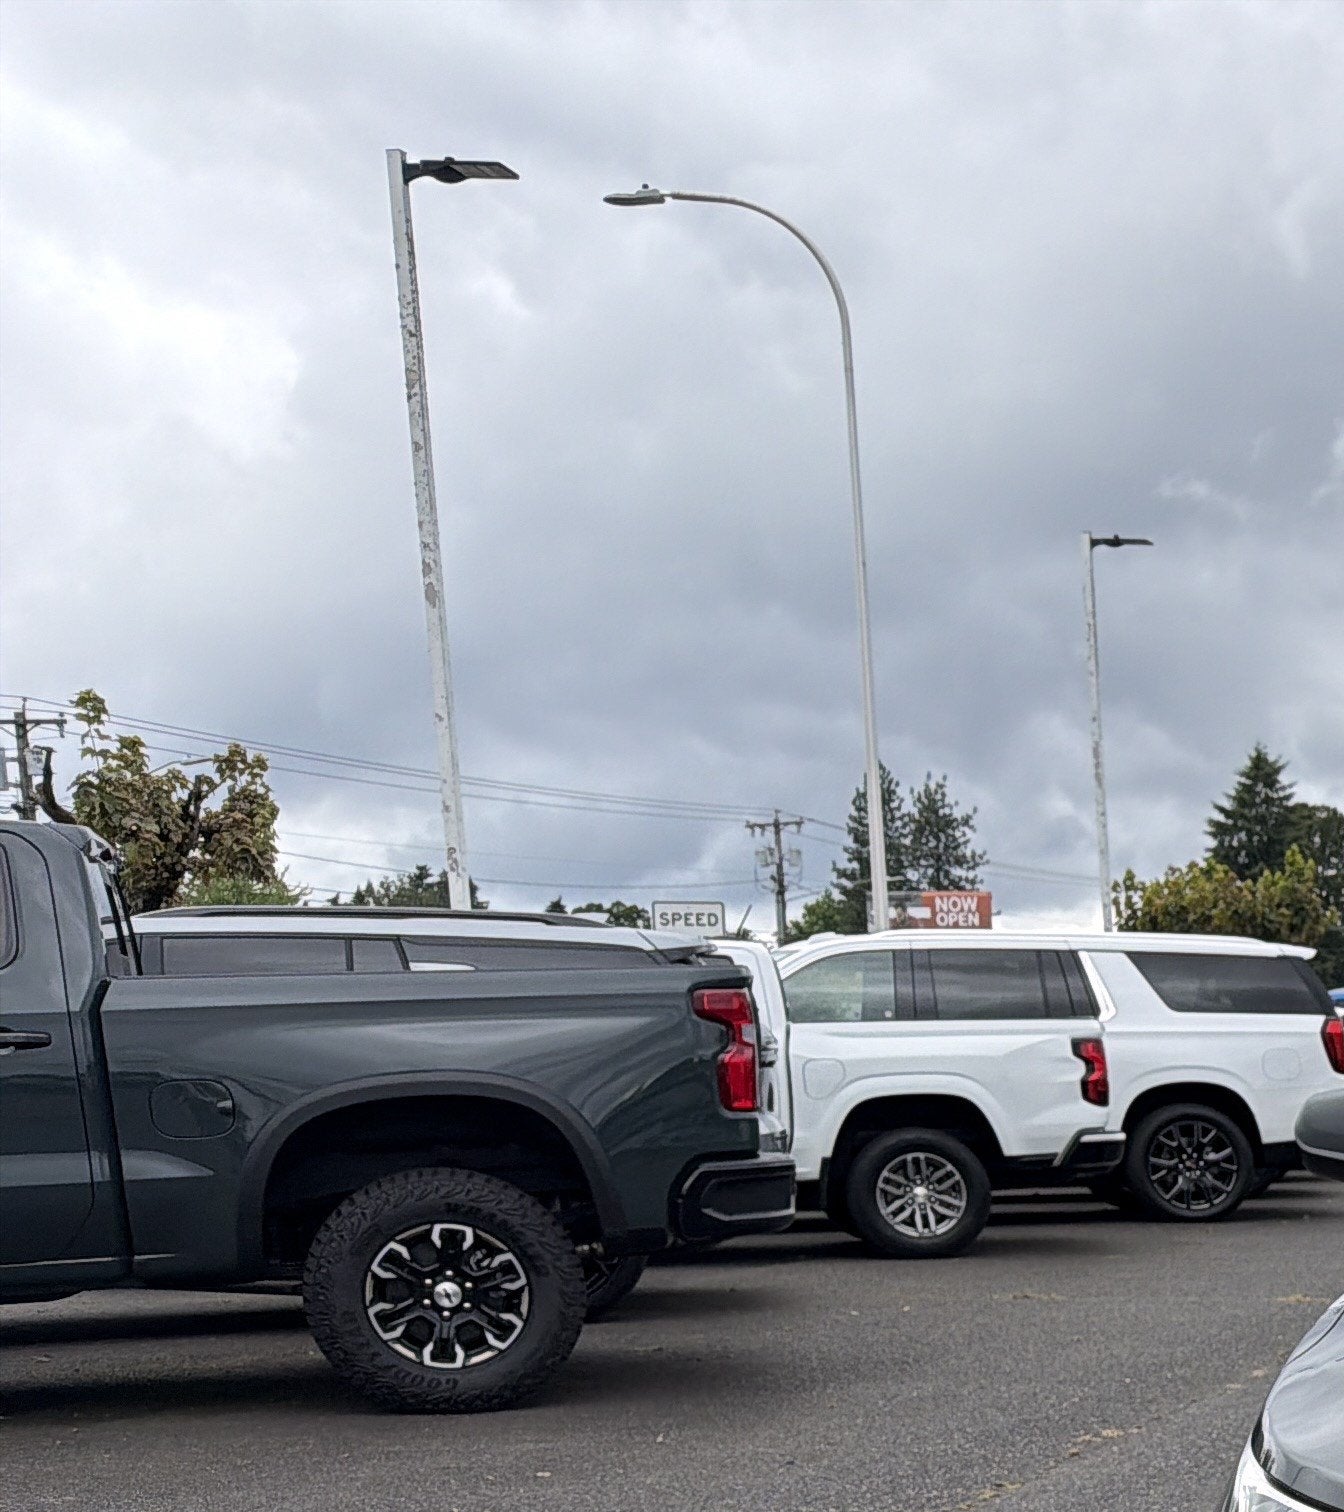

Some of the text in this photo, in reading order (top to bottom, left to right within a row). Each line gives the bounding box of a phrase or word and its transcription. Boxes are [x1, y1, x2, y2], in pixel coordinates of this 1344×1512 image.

[934, 895, 978, 913] NOW
[659, 911, 719, 927] SPEED
[935, 911, 980, 927] OPEN
